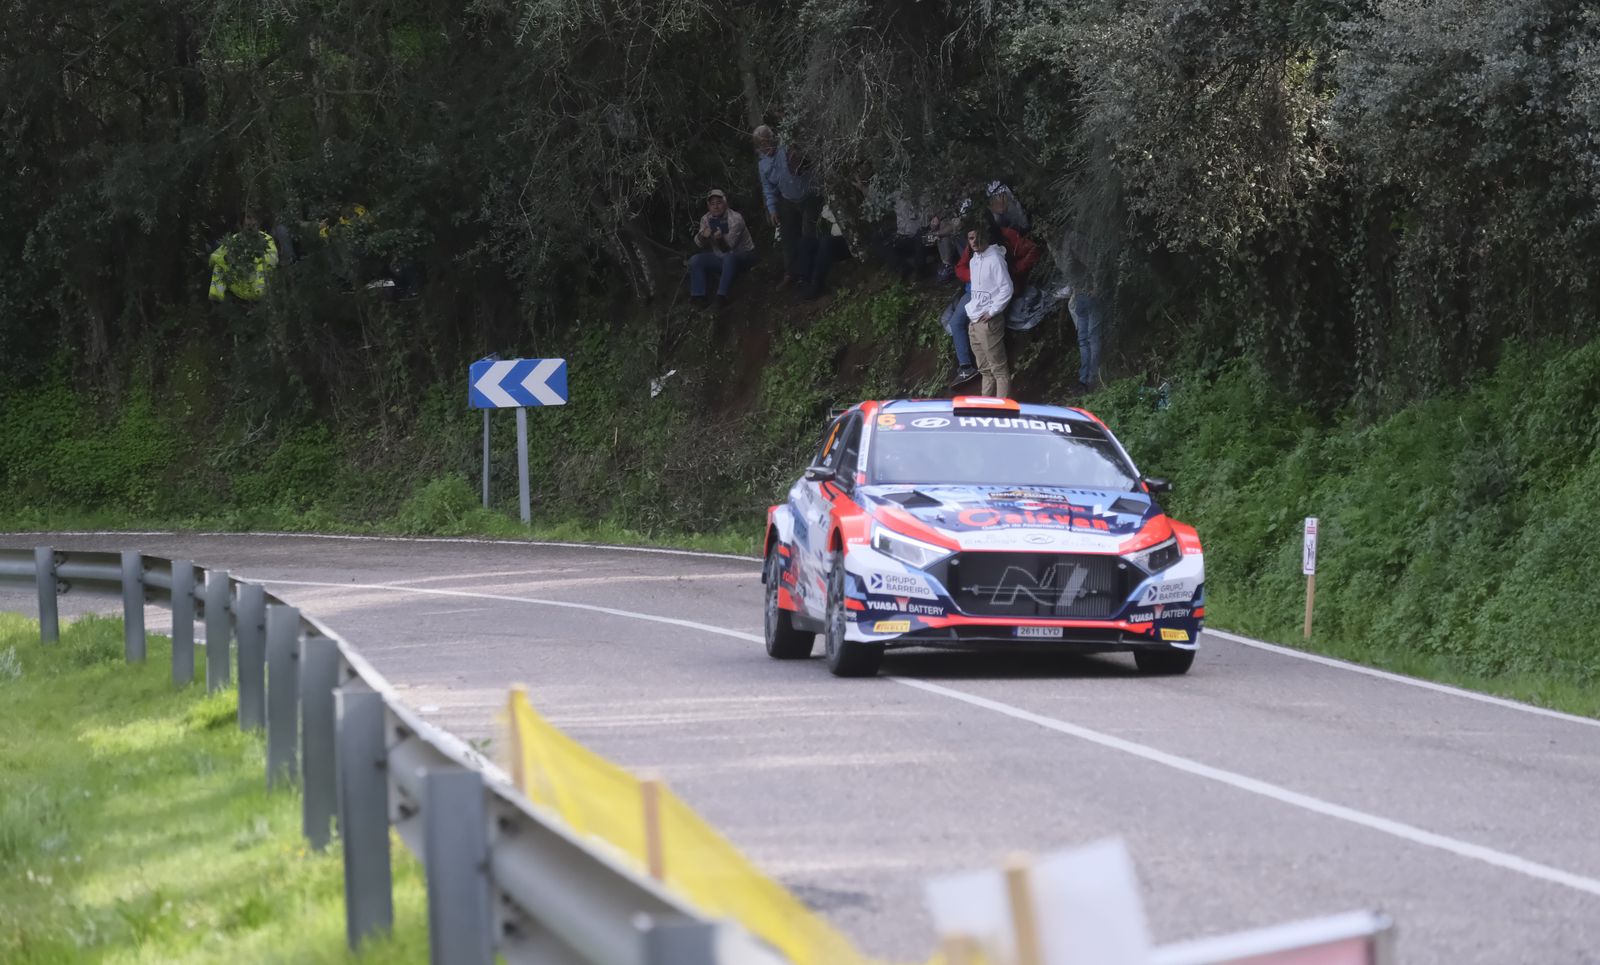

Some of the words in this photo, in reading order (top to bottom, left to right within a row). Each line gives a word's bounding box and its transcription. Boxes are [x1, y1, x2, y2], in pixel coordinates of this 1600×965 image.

[878, 413, 897, 426] 6
[959, 416, 1072, 434] HYUNDAI
[885, 574, 917, 586] GRUPO
[886, 583, 930, 595] BARREIRO
[1160, 582, 1184, 593] GRUPO
[1159, 591, 1194, 601] BARREIRO
[867, 601, 898, 611] YUASA
[908, 604, 944, 615] BATTERY
[1130, 612, 1154, 622] YUASA
[1162, 609, 1191, 619] BATTERY
[1020, 627, 1040, 635] 2611
[1042, 628, 1060, 636] LYD
